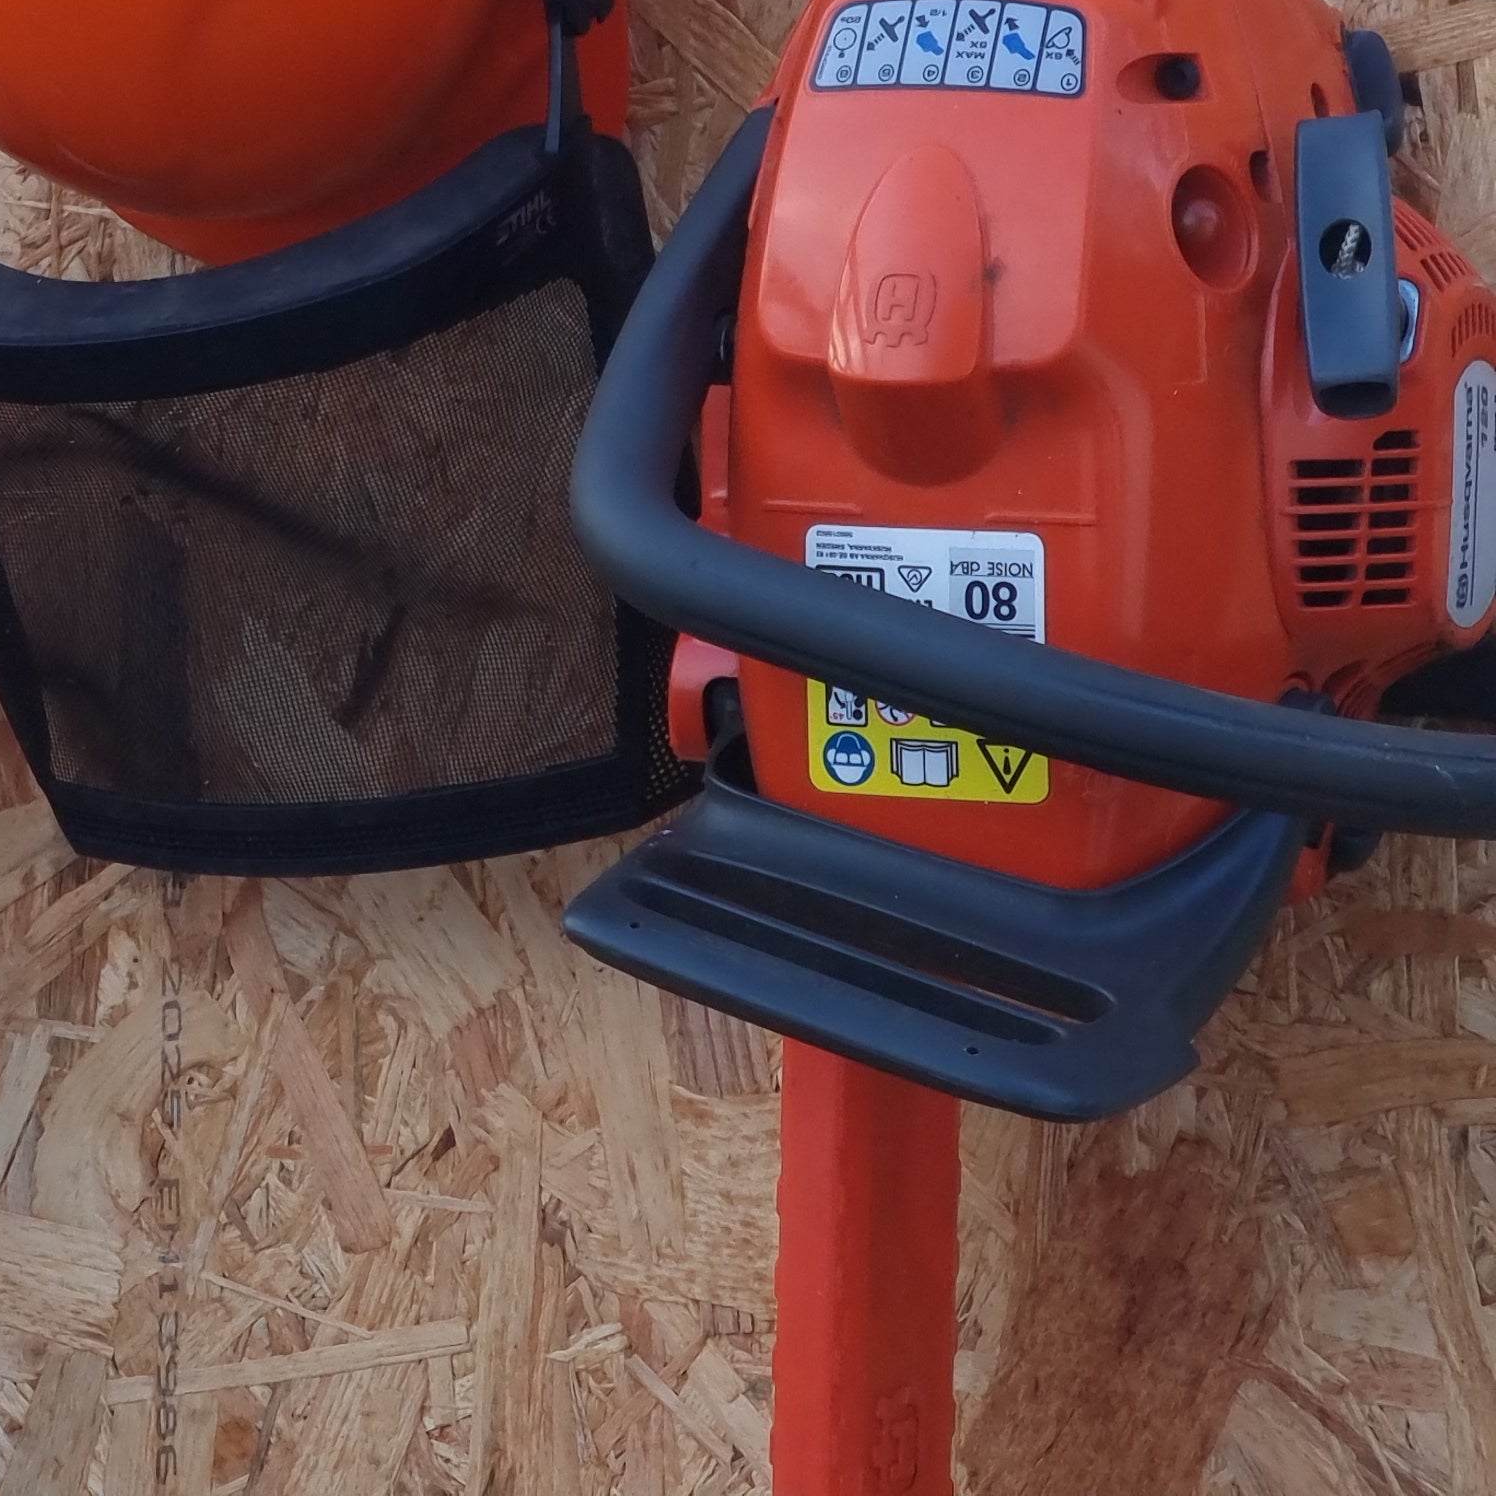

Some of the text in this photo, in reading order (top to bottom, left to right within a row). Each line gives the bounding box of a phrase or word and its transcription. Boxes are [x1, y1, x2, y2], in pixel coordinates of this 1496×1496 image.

[955, 51, 986, 60] MAX
[1458, 386, 1474, 571] Husqvarna
[950, 560, 1034, 578] NOISE dBA
[964, 579, 1018, 622] 80
